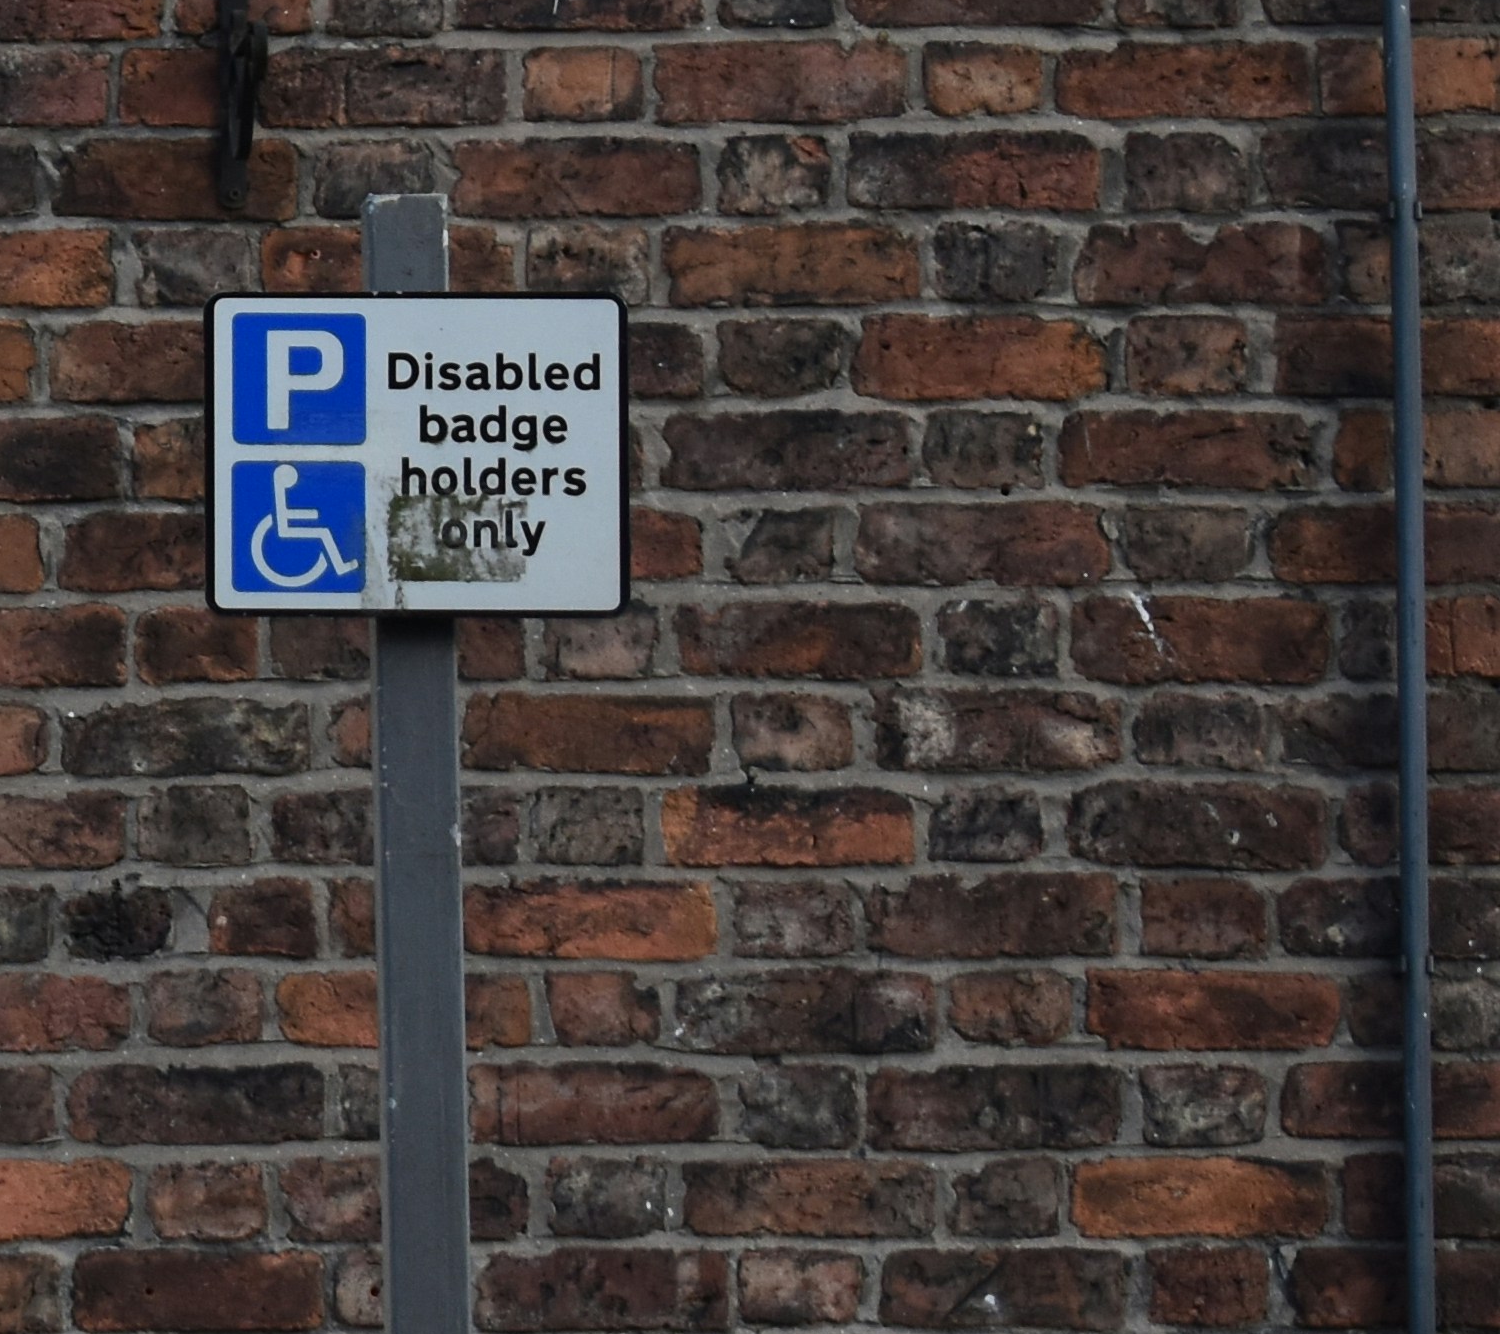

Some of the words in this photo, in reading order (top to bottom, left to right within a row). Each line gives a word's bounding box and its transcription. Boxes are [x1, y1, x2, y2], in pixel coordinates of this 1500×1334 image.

[266, 329, 344, 430] P
[387, 352, 601, 391] Disabled
[419, 404, 568, 451] badge
[401, 457, 587, 496] holders
[441, 510, 546, 557] only
